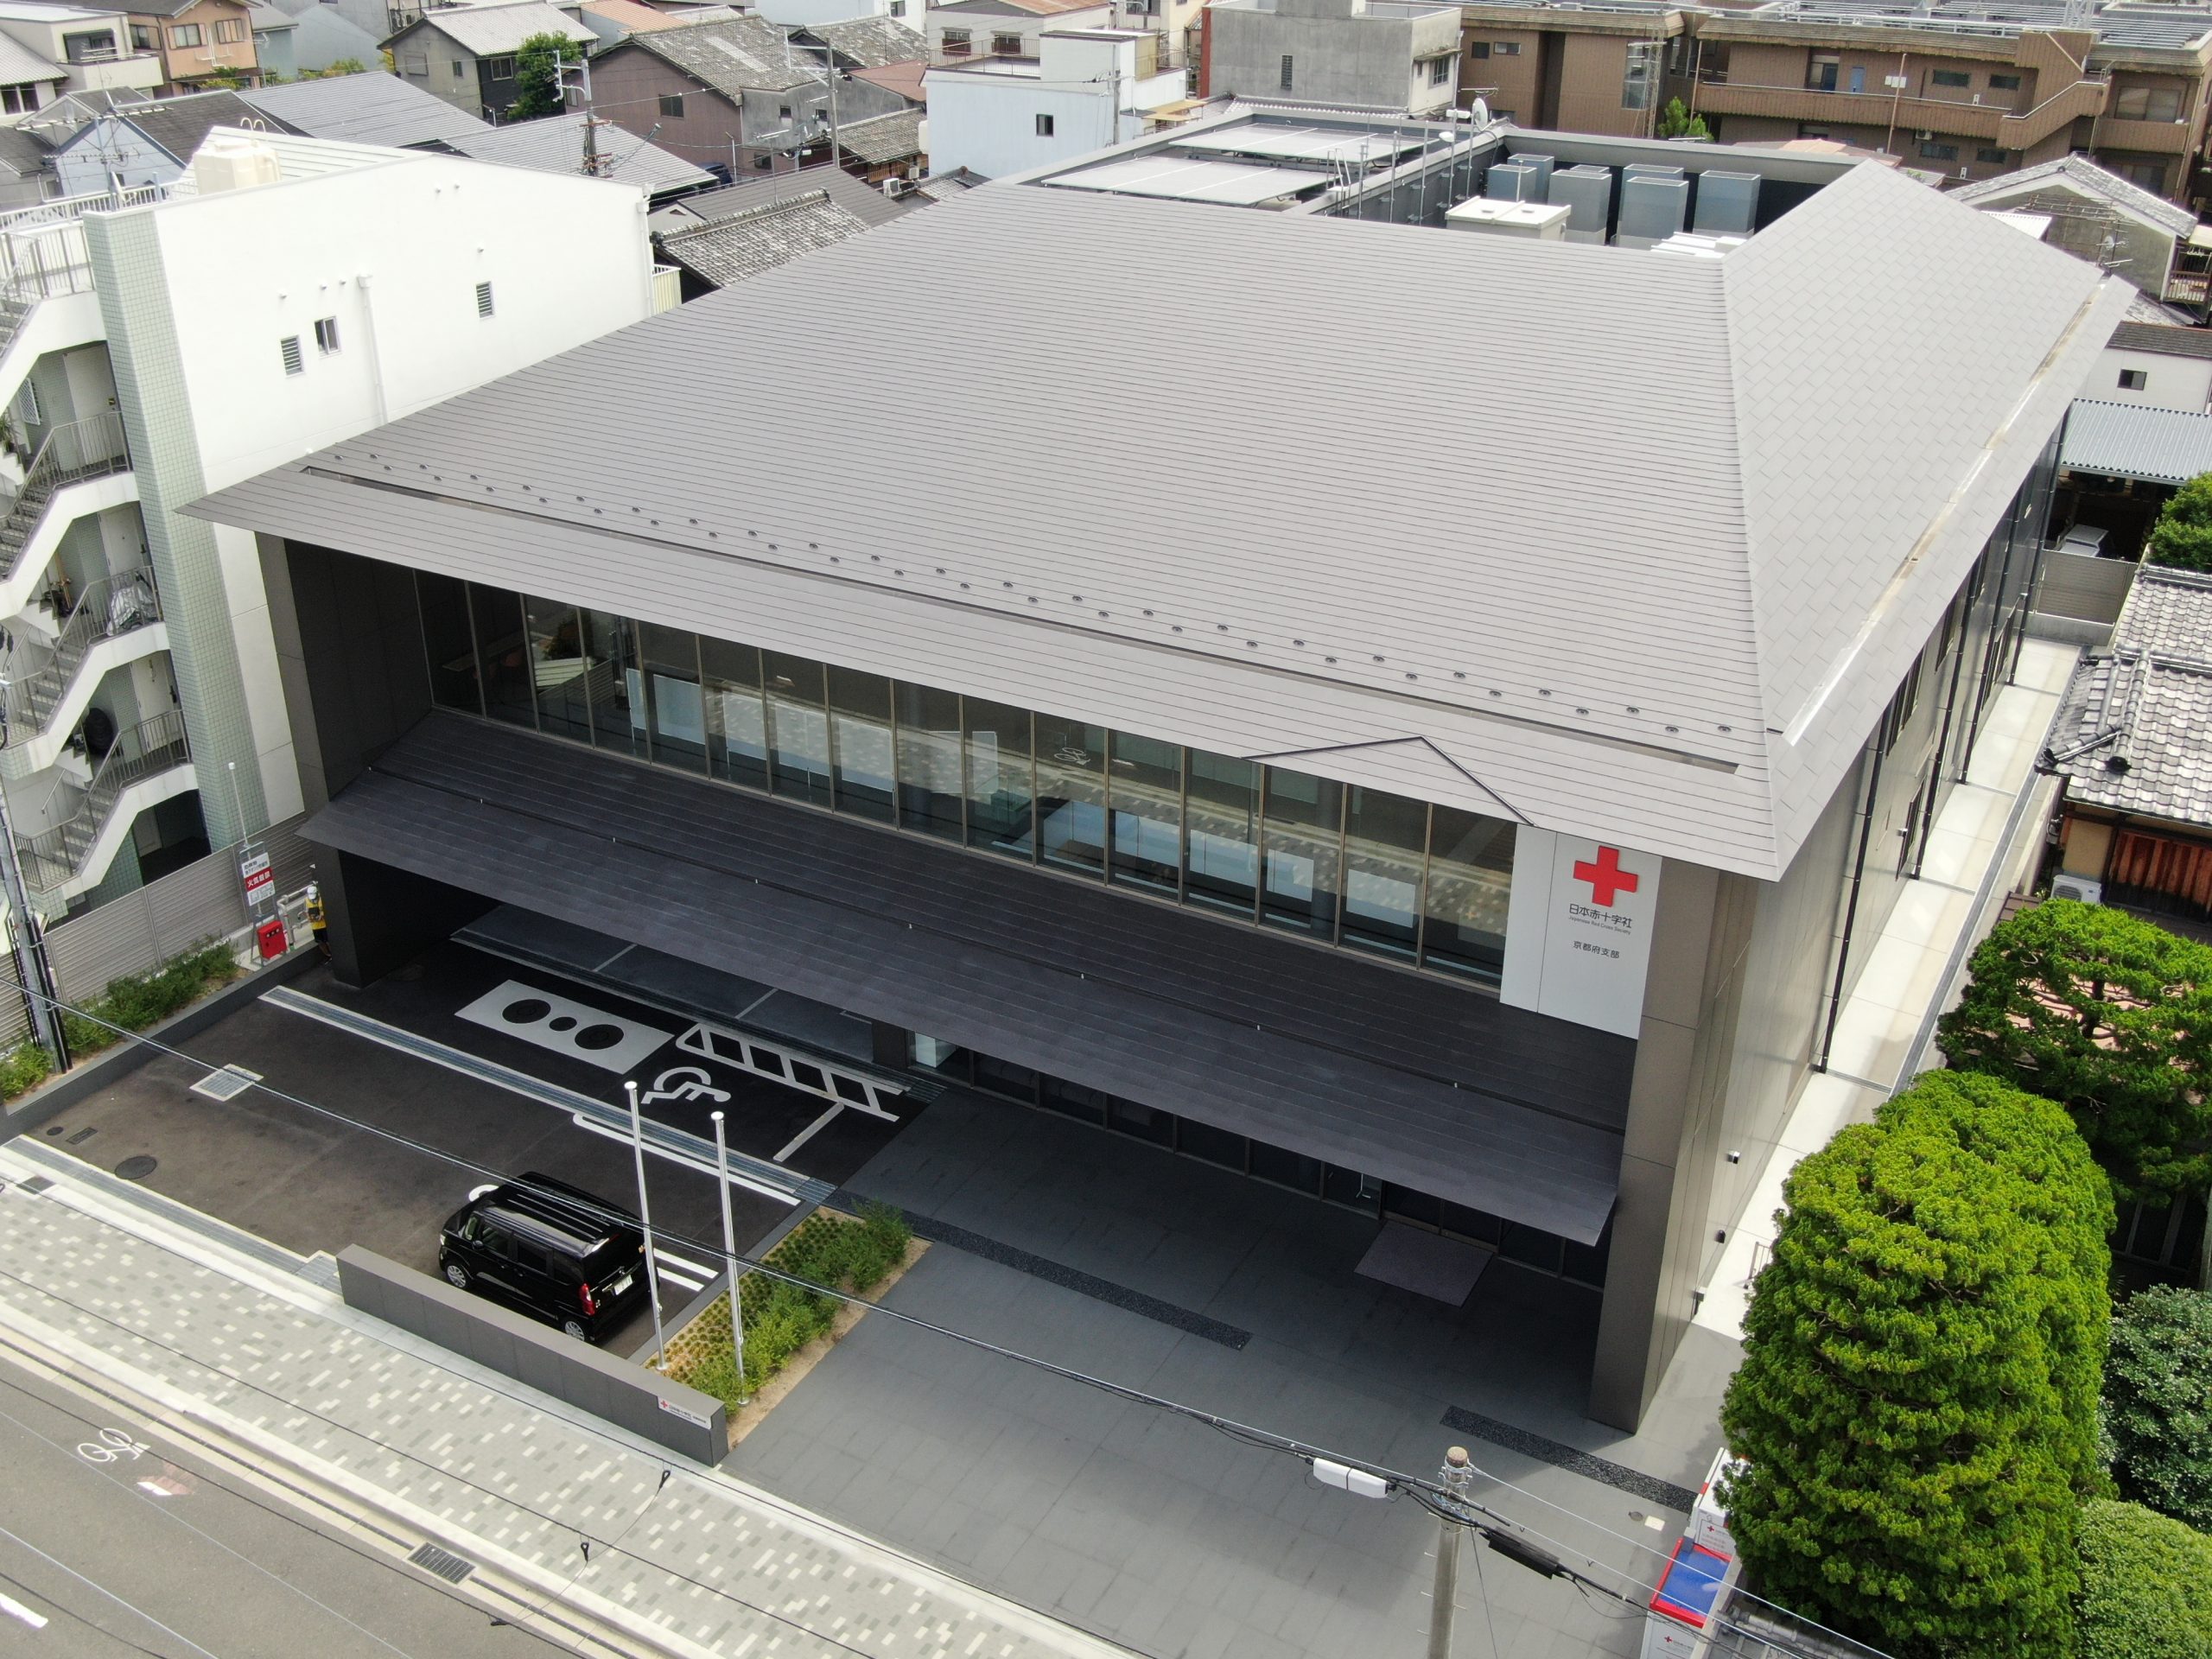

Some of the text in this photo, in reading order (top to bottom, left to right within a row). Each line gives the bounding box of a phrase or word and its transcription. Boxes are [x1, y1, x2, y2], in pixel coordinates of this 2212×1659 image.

[1569, 903, 1632, 928] 日本赤十字社
[1573, 940, 1619, 958] 京都府支部
